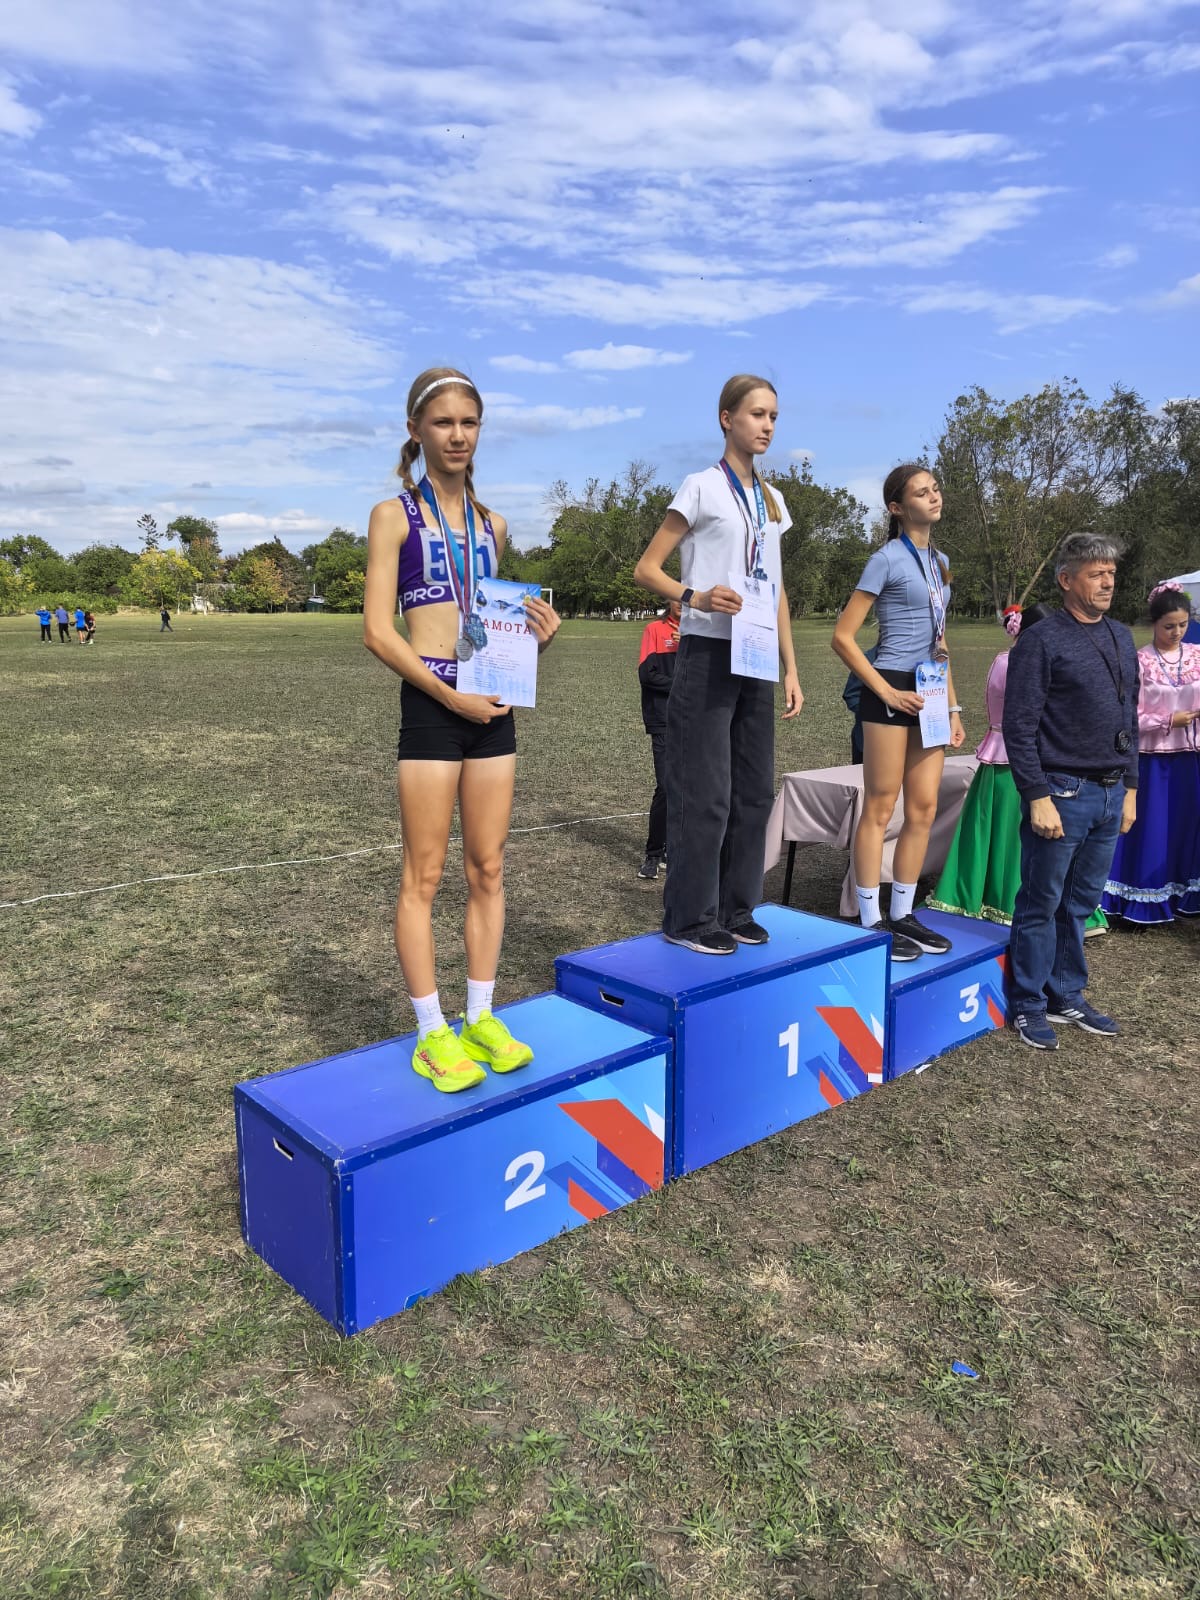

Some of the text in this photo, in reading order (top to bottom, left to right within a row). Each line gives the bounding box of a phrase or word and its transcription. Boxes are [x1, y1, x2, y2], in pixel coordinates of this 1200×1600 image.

[402, 493, 418, 516] PRO
[429, 541, 494, 581] 51
[403, 586, 446, 606] PRO
[483, 618, 532, 635] АМОТА
[423, 660, 457, 676] IKE
[959, 982, 980, 1023] 3
[778, 1022, 799, 1077] 1
[504, 1150, 546, 1212] 2
